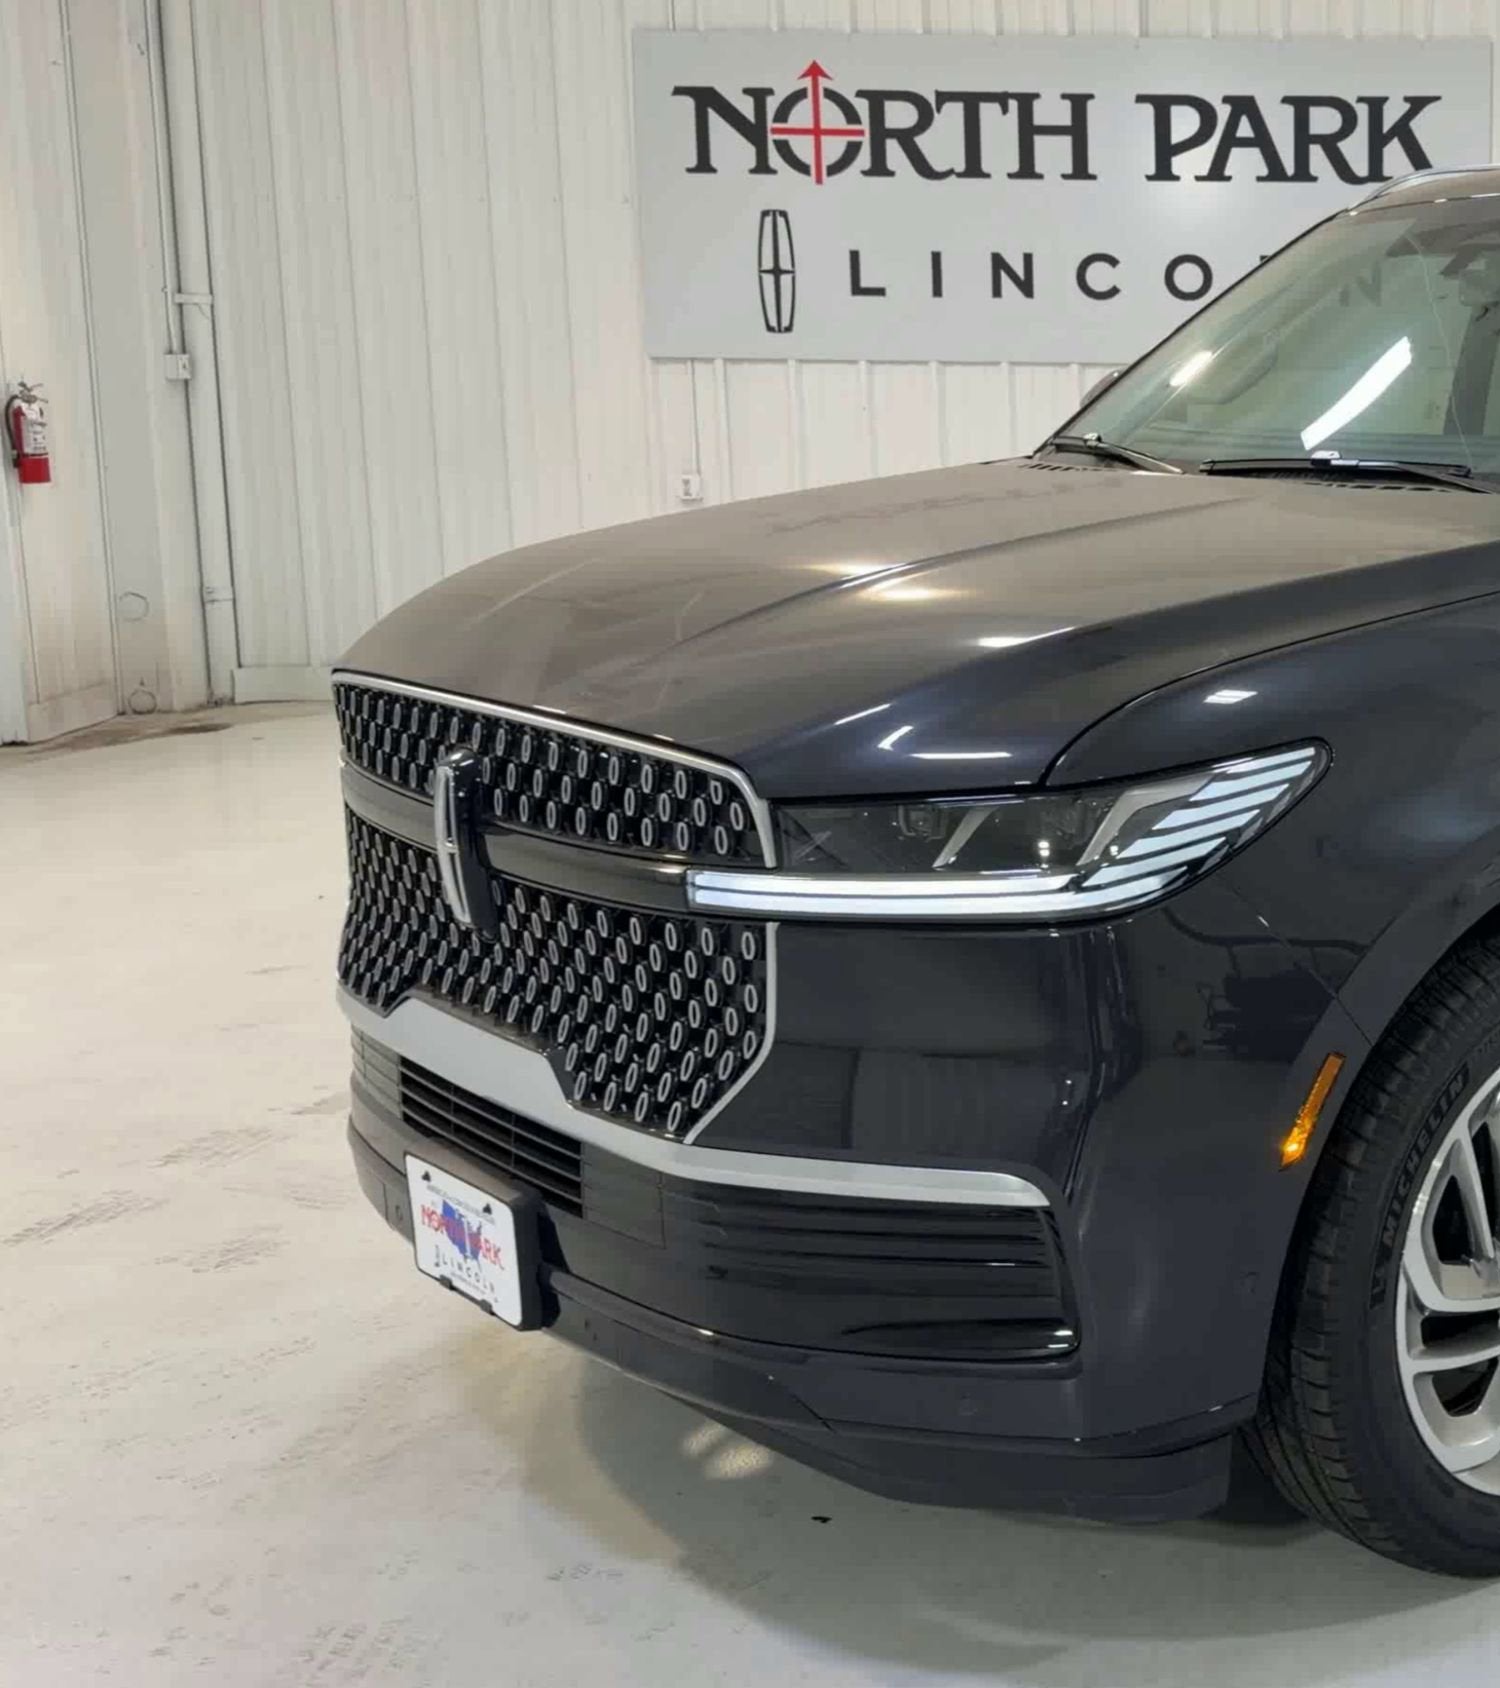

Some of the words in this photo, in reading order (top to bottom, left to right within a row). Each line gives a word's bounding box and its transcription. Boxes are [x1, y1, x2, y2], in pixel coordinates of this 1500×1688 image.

[671, 86, 1097, 181] NORTH
[1135, 94, 1443, 185] PARK
[1381, 1071, 1467, 1249] MICHELIN
[442, 1252, 495, 1293] LINCOLN
